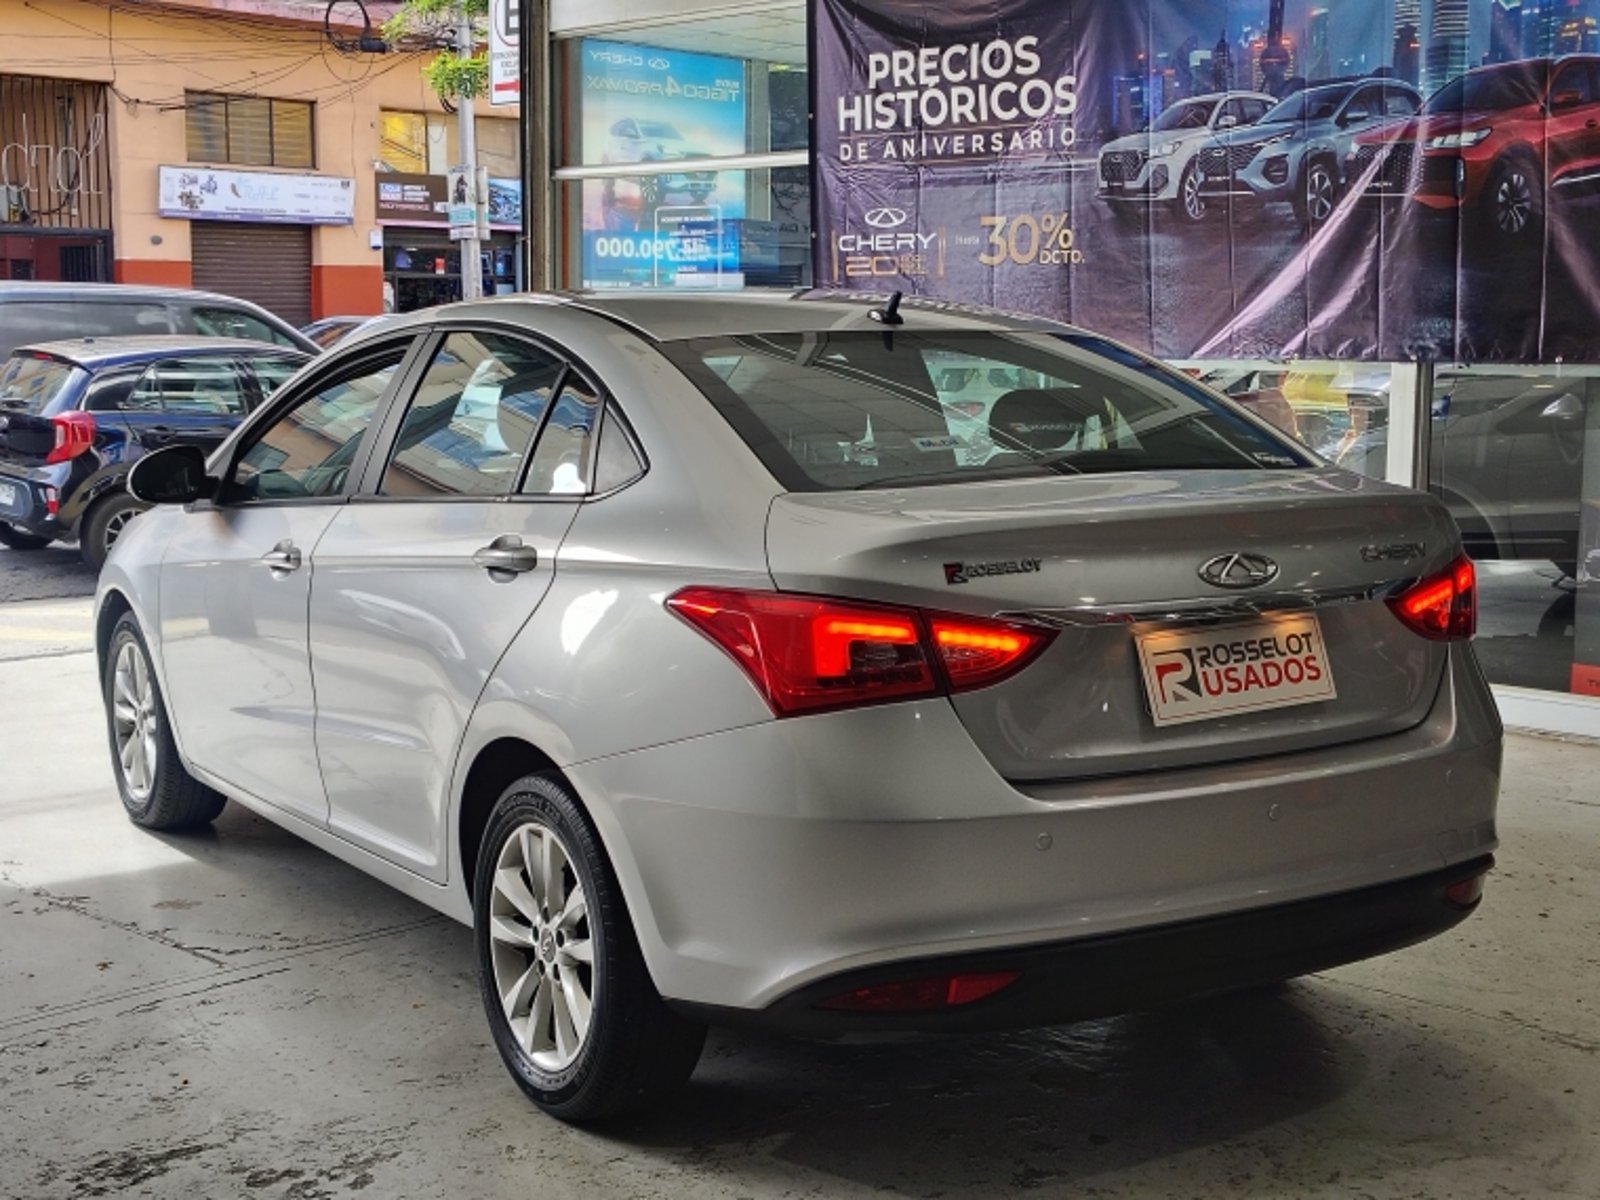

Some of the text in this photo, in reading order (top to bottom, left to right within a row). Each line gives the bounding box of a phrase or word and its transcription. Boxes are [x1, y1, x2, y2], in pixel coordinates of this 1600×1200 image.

[868, 35, 1041, 89] PRECIOS
[837, 75, 1077, 131] HISTÓRICOS
[839, 128, 1076, 161] DE ANIVERSARIO
[839, 233, 937, 251] CHERY
[978, 212, 1074, 266] 30%
[1198, 632, 1313, 668] ROSSELOT
[1202, 655, 1322, 696] USADOS
